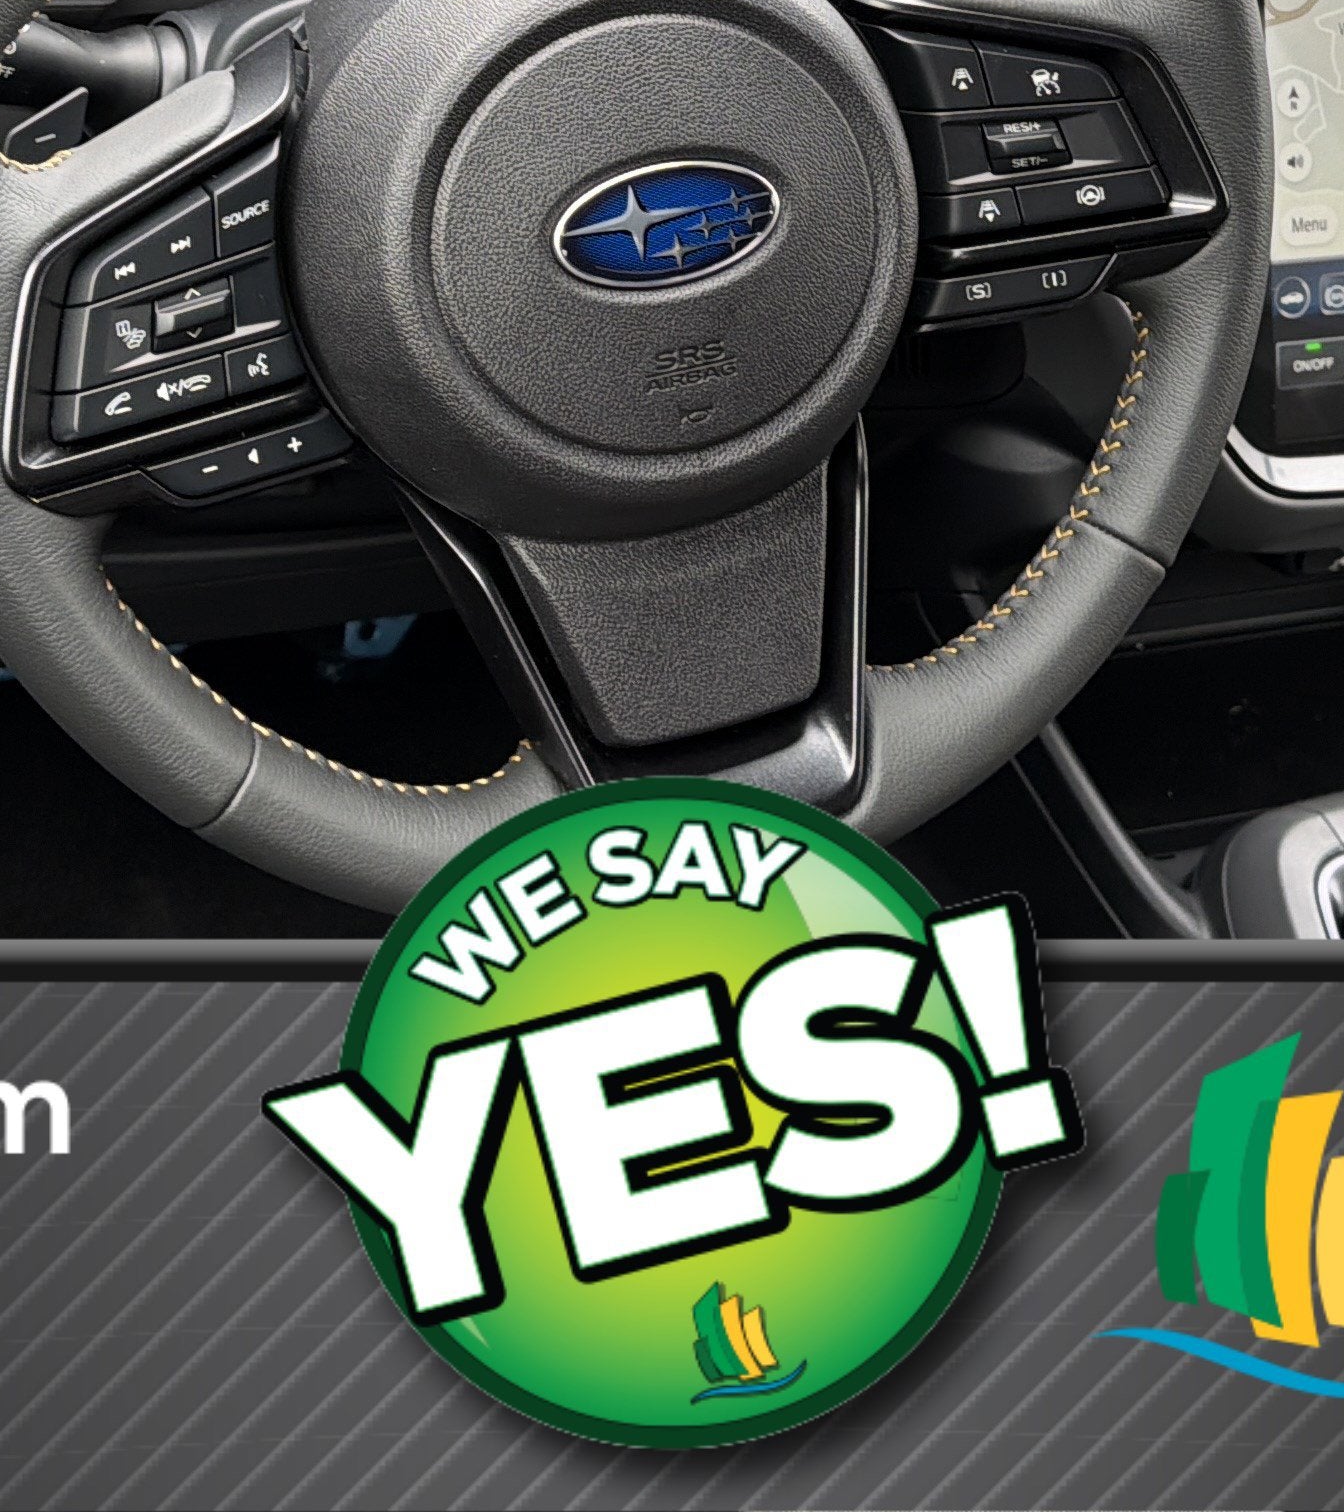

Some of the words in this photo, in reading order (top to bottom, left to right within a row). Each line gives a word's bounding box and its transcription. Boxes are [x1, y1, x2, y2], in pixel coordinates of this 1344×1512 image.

[221, 199, 270, 229] SOURCE
[1291, 218, 1328, 233] Menu
[654, 340, 726, 373] SRS
[1292, 357, 1335, 372] ON/OFF
[645, 363, 739, 396] AIRBAG
